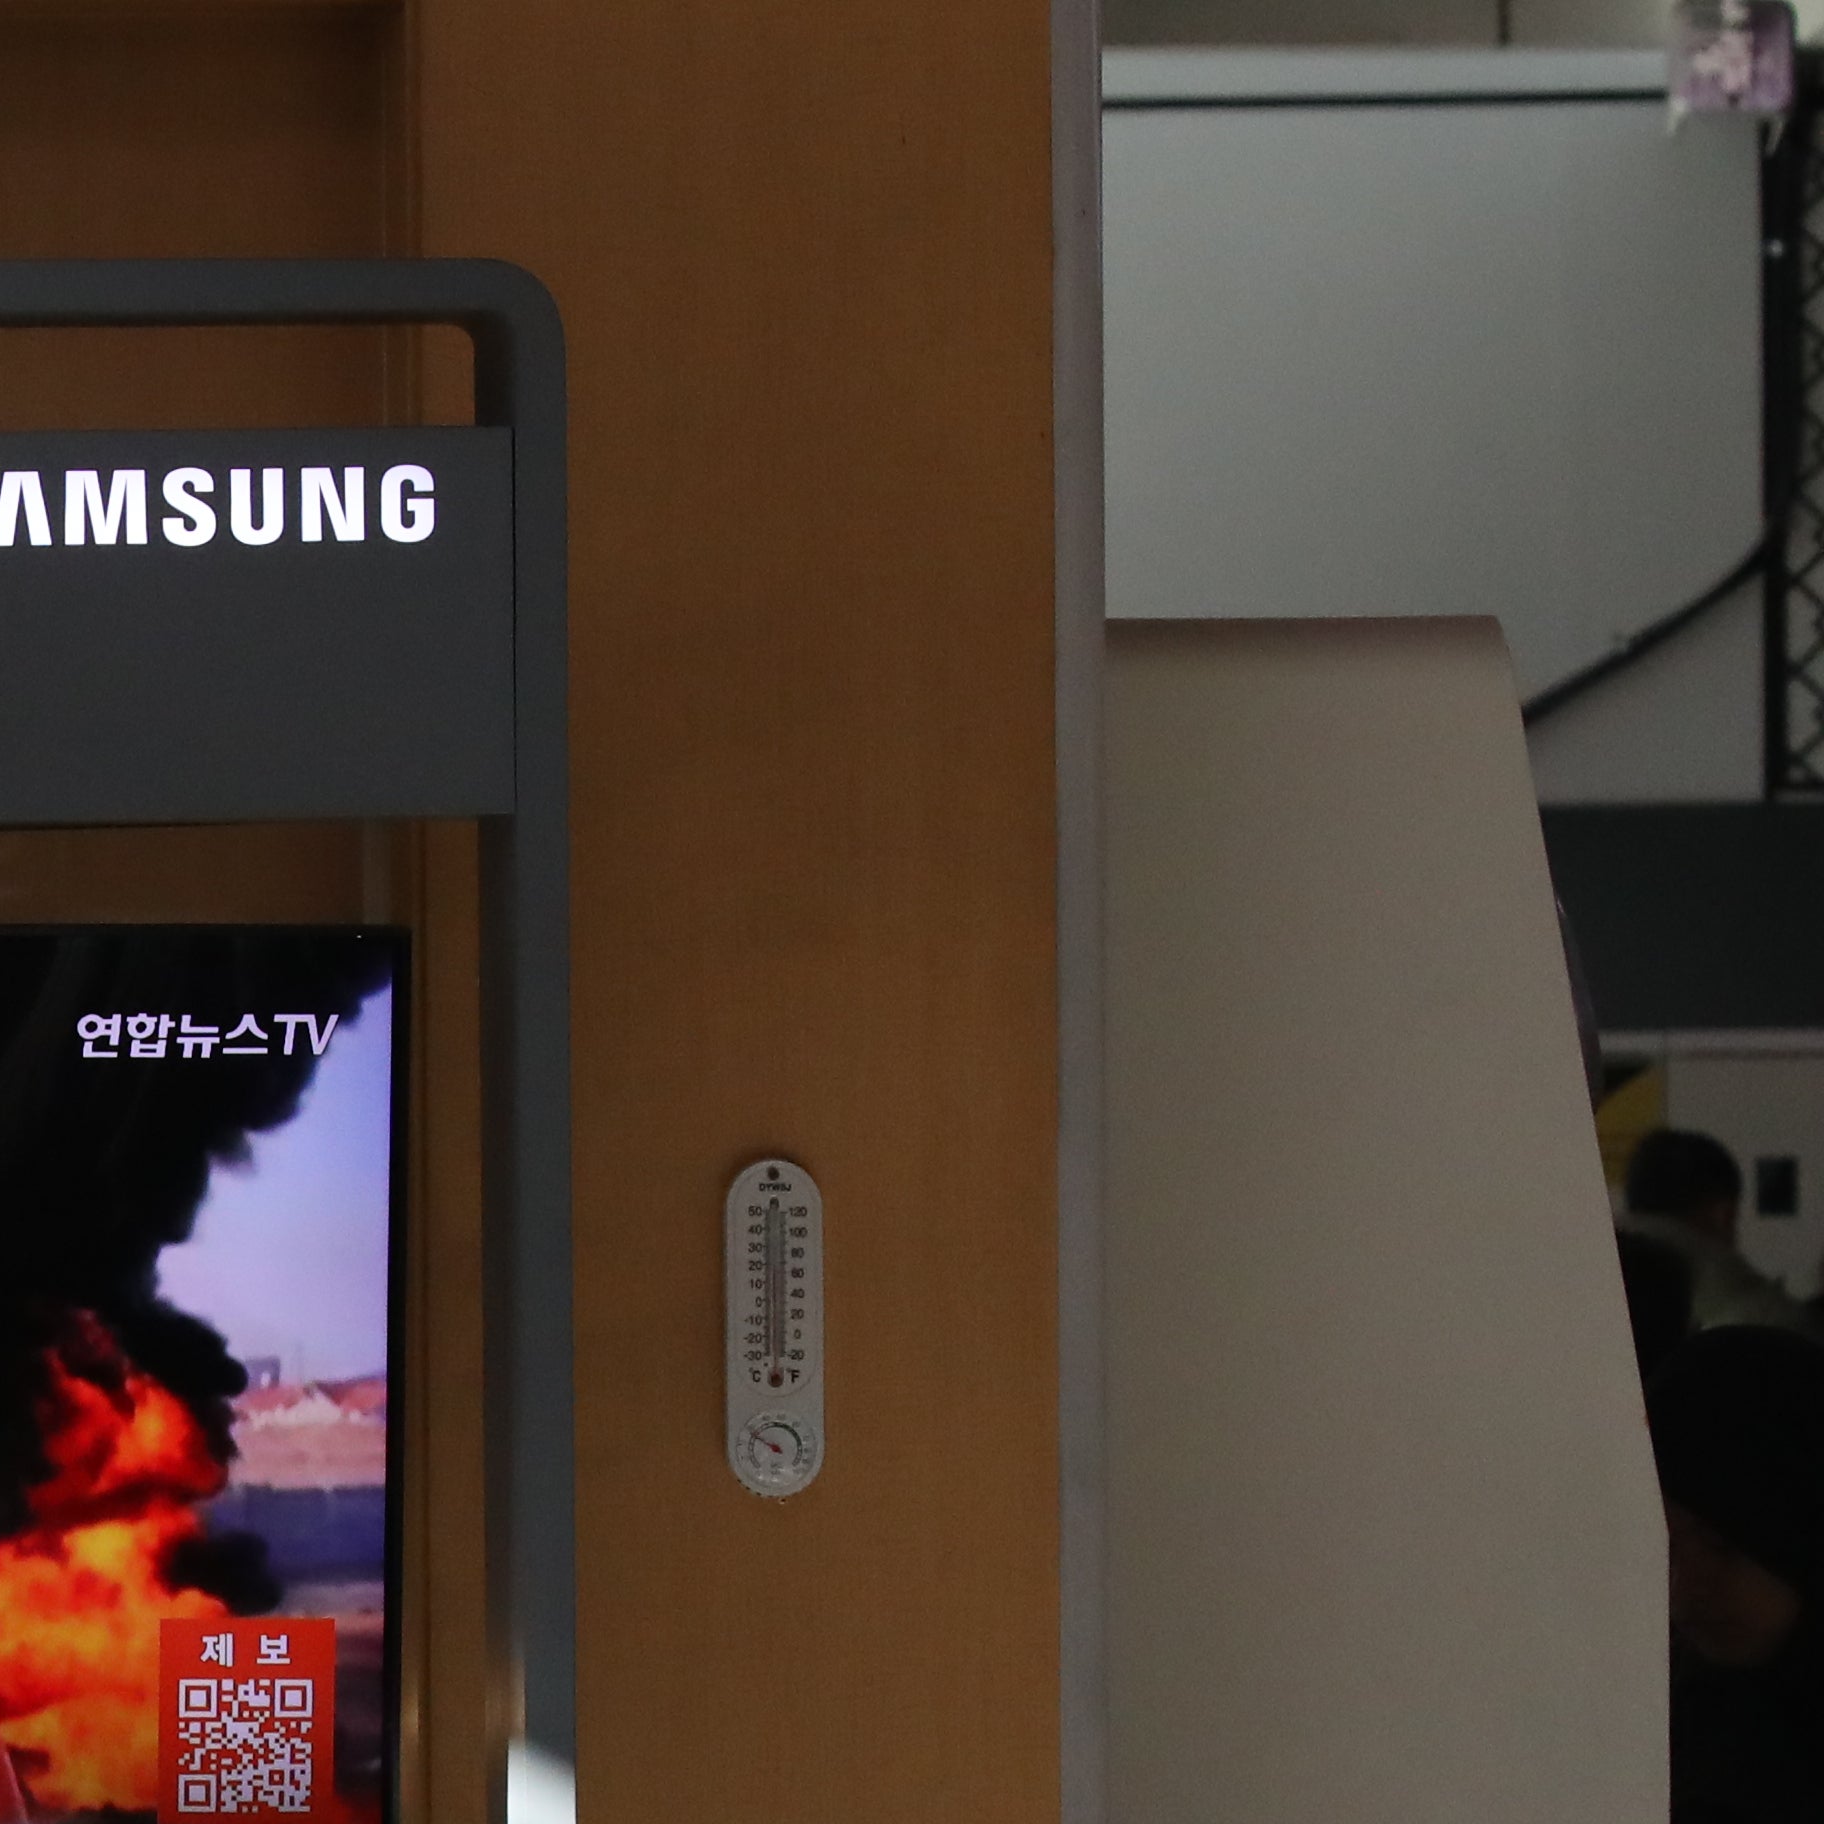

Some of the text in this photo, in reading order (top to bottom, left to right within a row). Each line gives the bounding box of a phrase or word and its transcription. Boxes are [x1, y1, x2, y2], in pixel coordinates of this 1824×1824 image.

[77, 1013, 339, 1058] 연합뉴스TV
[748, 1206, 762, 1216] 50
[749, 1260, 762, 1270] 20
[750, 1278, 762, 1289] 10
